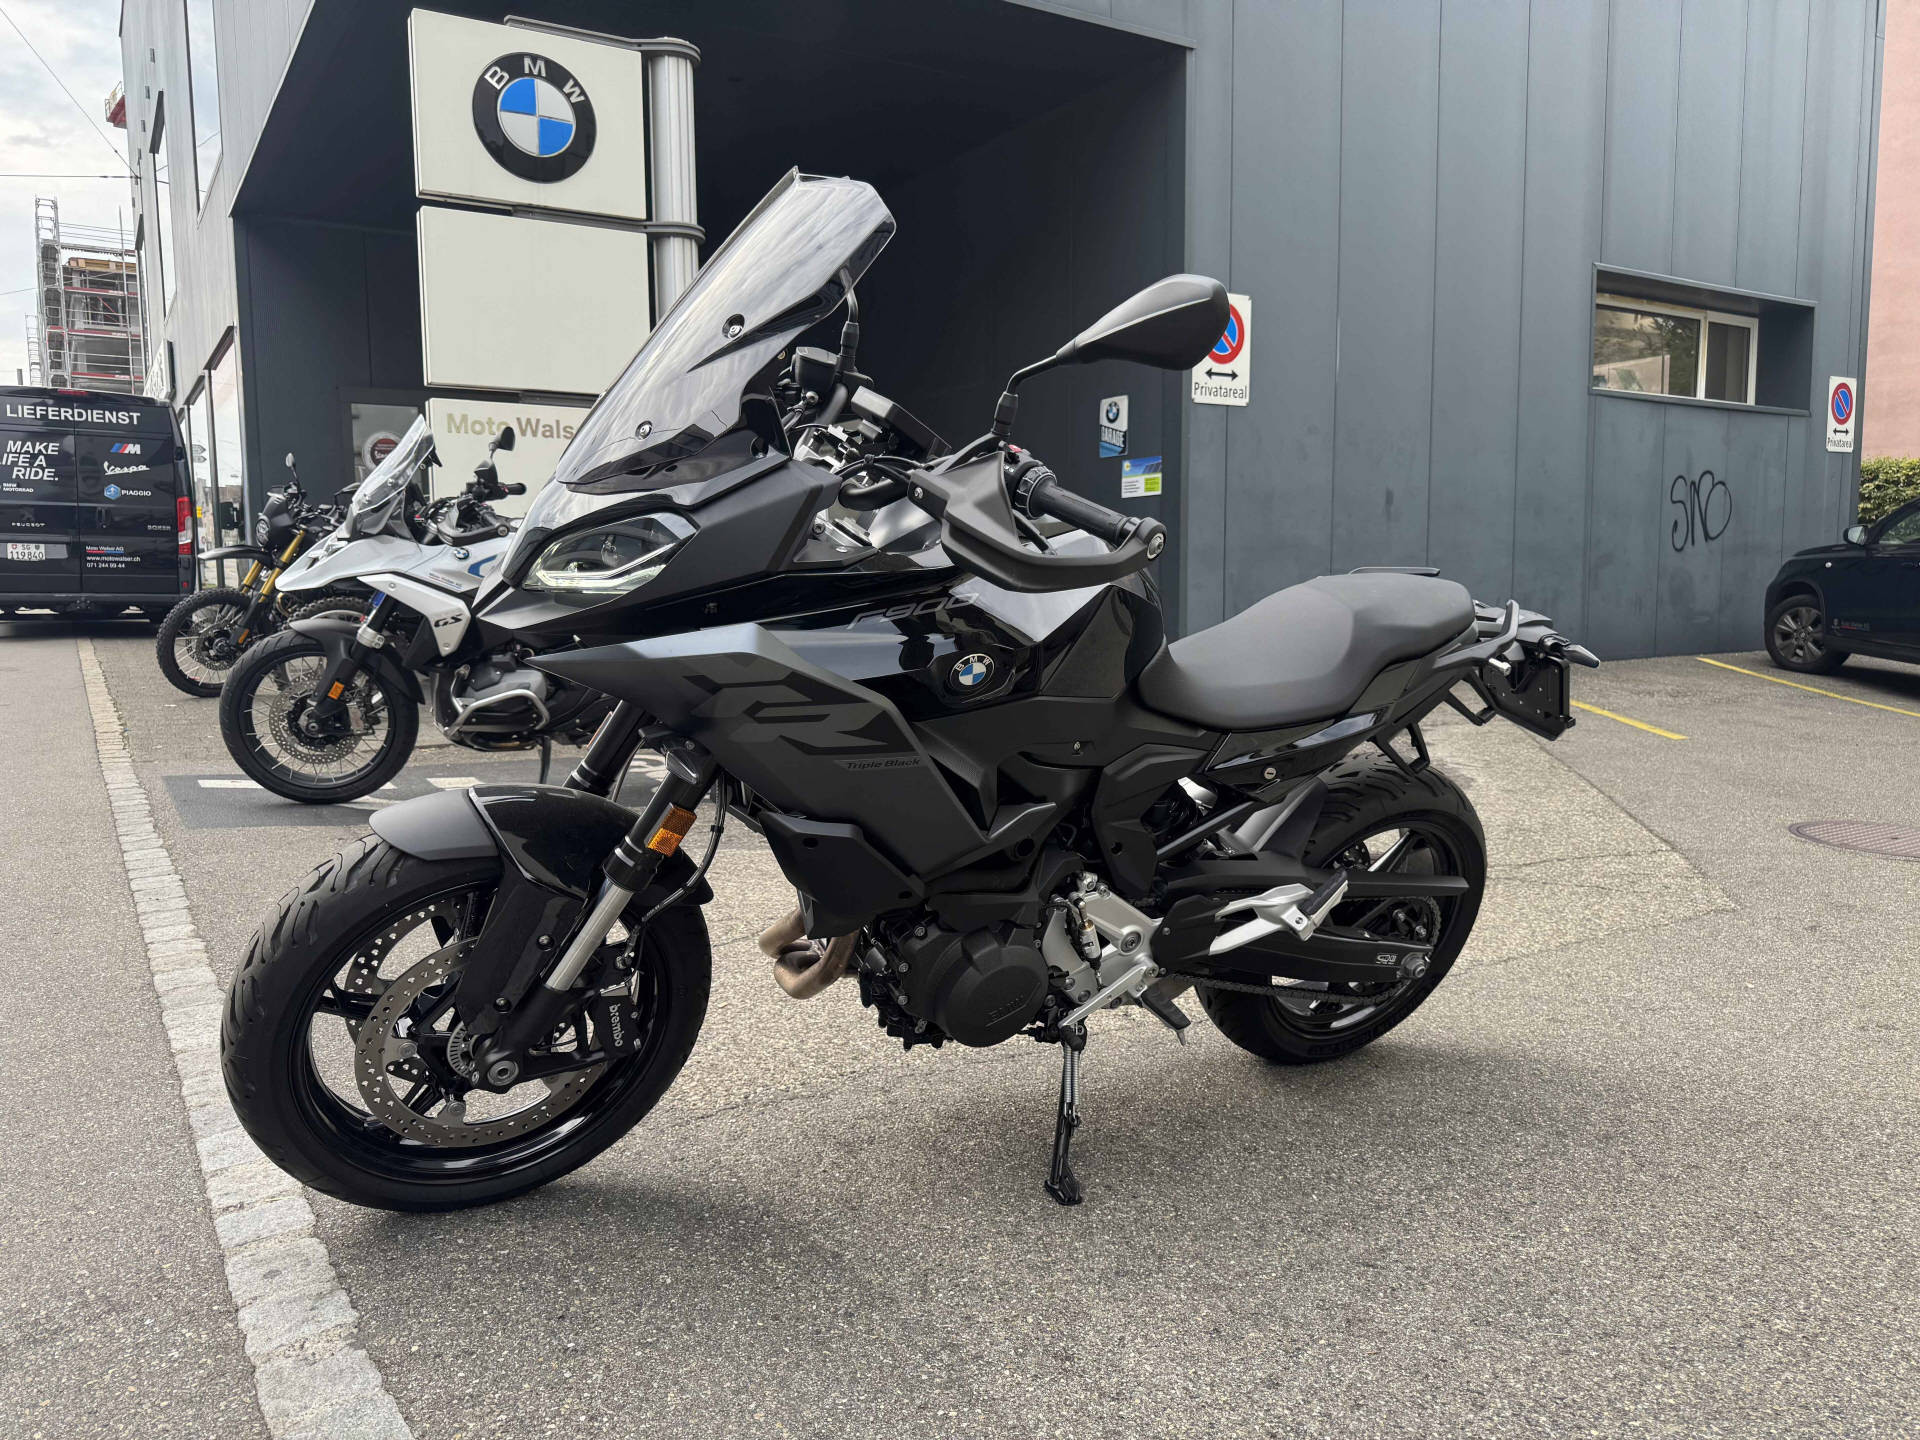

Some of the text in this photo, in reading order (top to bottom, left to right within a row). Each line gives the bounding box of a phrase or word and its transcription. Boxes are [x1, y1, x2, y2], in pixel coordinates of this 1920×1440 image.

[484, 56, 585, 104] BMW
[1193, 382, 1248, 400] Privatareal
[6, 404, 141, 425] LIEFERDIENST
[6, 440, 60, 455] MAKE
[0, 453, 47, 468] IFE A
[12, 467, 59, 481] RIDE.
[103, 461, 150, 476] Vespa
[121, 489, 152, 497] PIAGGIO
[434, 613, 463, 628] GS
[955, 655, 991, 672] BMW
[847, 758, 921, 770] Triple Black
[608, 1004, 624, 1048] brembo
